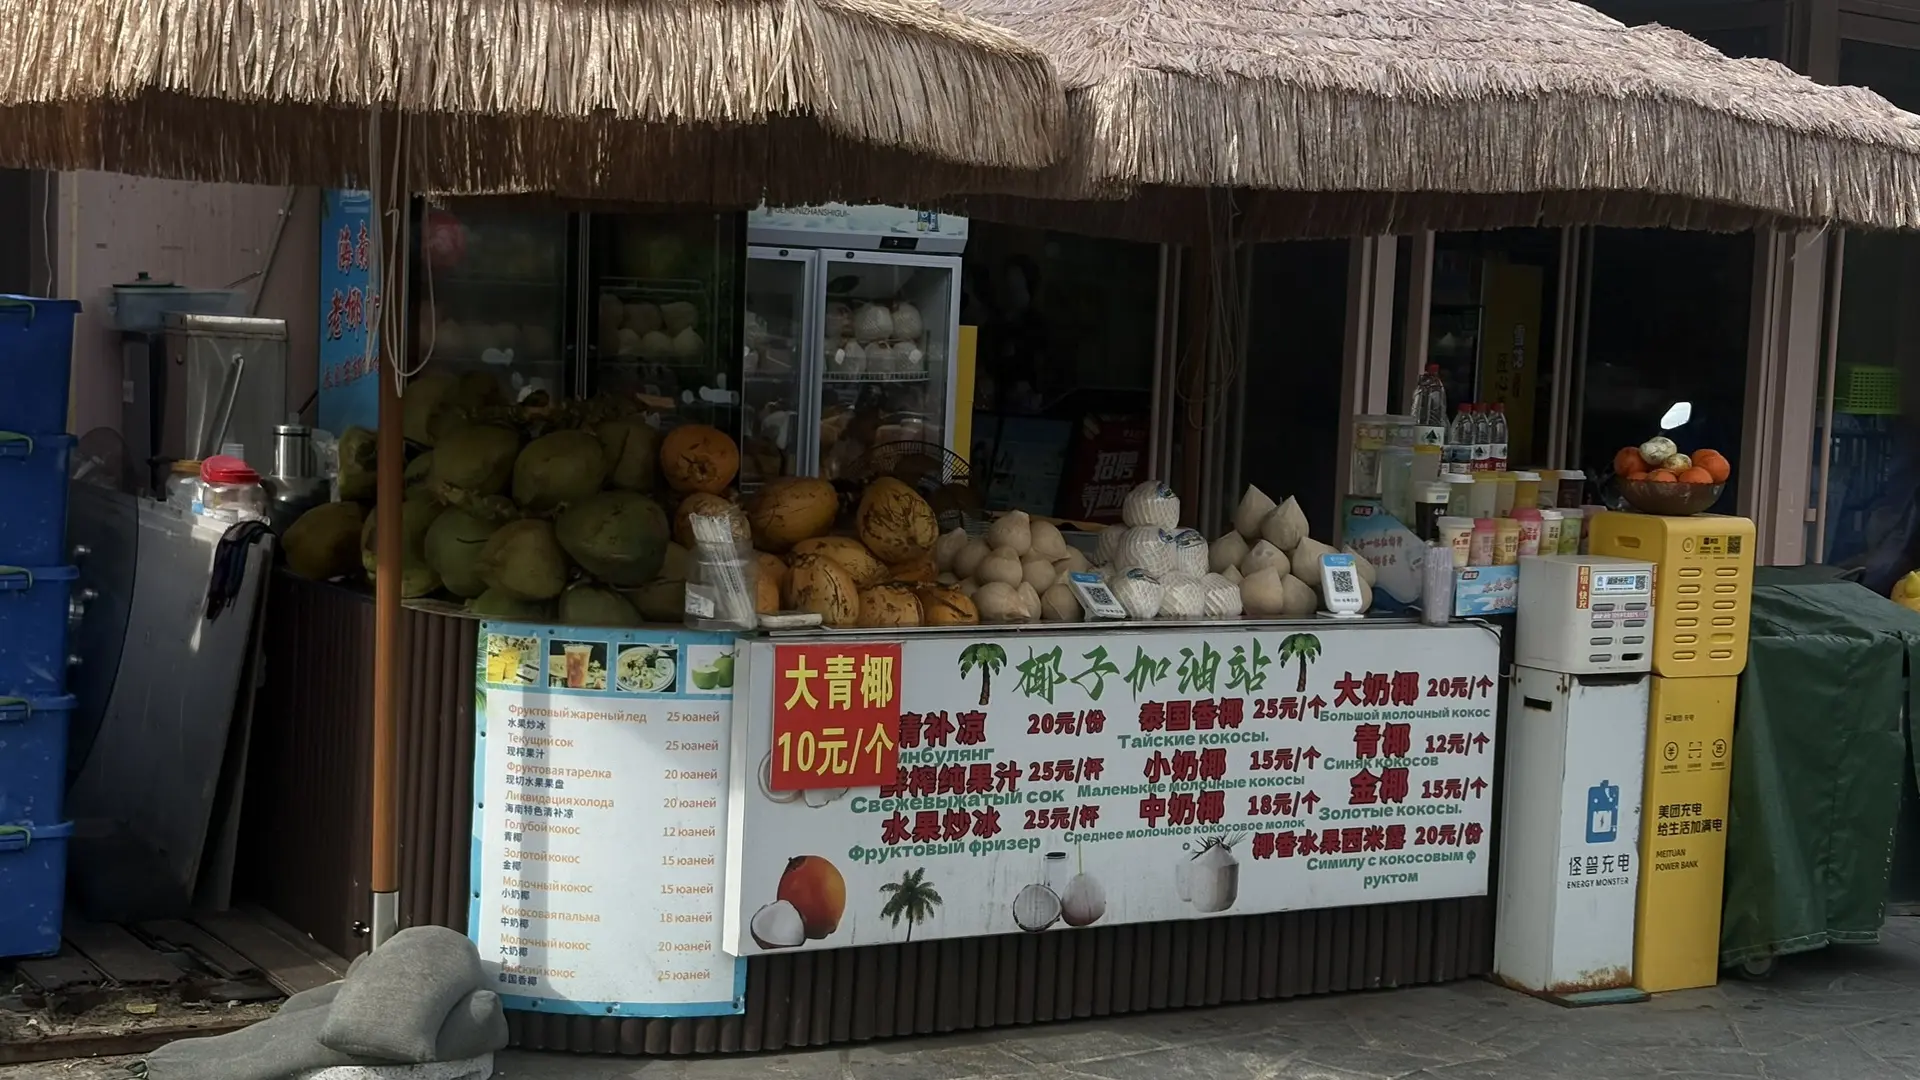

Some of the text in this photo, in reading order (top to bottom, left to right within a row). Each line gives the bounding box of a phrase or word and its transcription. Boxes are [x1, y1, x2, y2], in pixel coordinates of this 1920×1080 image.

[1012, 638, 1272, 704] 椰子加油站
[785, 653, 894, 711] 大青椰
[1334, 671, 1494, 708] 大奶椰 20元/个
[667, 711, 680, 722] 25
[682, 710, 720, 723] юаней
[1139, 695, 1327, 732] 泰国香椰 25元/个
[1320, 707, 1491, 721] Большой молочный кокос
[507, 717, 546, 731] 水果炒冰
[1027, 710, 1106, 736] 20元/份
[555, 739, 574, 748] сок
[665, 741, 679, 751] 25
[681, 739, 719, 752] юаней
[1117, 730, 1269, 749] Тайские кокосы.
[1353, 723, 1490, 759] 青椰 12元/个
[506, 746, 545, 760] 现榨果汁
[778, 722, 894, 776] 10元/个
[898, 747, 995, 767] инбулянг
[1029, 757, 1104, 784] 25元/杯
[1143, 746, 1322, 784] 小奶椰 15元/个
[1324, 755, 1439, 770] Синяк кокосов
[505, 774, 565, 790] 现切水果果盘
[566, 769, 612, 780] тарелка
[664, 769, 678, 780] 20
[680, 769, 718, 781] юаней
[1077, 775, 1305, 798] Маленькие молочные кокосы
[1349, 766, 1488, 805] 金椰 15元/个
[663, 798, 677, 808] 20
[679, 797, 716, 809] юаней
[850, 788, 1064, 814] Свежевыжатый сок
[1139, 790, 1321, 828] 中奶椰 18元/个
[1319, 800, 1462, 821] Золотые кокосы.
[1658, 803, 1702, 819] 美团充电
[549, 825, 580, 835] кокос
[663, 827, 676, 837] 12
[678, 826, 715, 838] юаней
[881, 805, 1099, 845] 水果炒冰 25元/杯
[1064, 819, 1305, 844] Среднее молочное кокосовое молок
[1657, 818, 1722, 836] 给生活加满电
[504, 831, 523, 842] 青椰
[1253, 822, 1483, 859] 椰香水果西米露 20元/份
[849, 836, 1041, 865] Фруктовый фризер
[1656, 848, 1686, 859] MEITUAN
[503, 860, 522, 871] 金椰
[548, 854, 580, 864] кокос
[661, 856, 674, 866] 15
[677, 855, 714, 867] юаней
[1307, 849, 1476, 873] Симилу с кокосовым ф
[1569, 852, 1630, 877] 怪兽充电
[1655, 860, 1699, 871] POWER BANK
[1364, 871, 1418, 889] руктом
[1567, 877, 1629, 889] ENERGY MONSTER
[501, 888, 530, 901] 小奶椰
[561, 883, 593, 893] кокос
[661, 884, 674, 894] 15
[676, 884, 713, 896] юаней
[501, 916, 529, 930] 中奶椰
[659, 913, 673, 923] 18
[675, 912, 712, 924] юаней
[500, 945, 528, 957] 大奶椰
[558, 941, 591, 951] кокос
[658, 942, 672, 952] 20
[674, 941, 711, 952] юаней
[498, 973, 537, 987] 泰国香椰
[544, 968, 576, 978] кокос
[658, 970, 671, 981] 25
[673, 969, 710, 981] юаней
